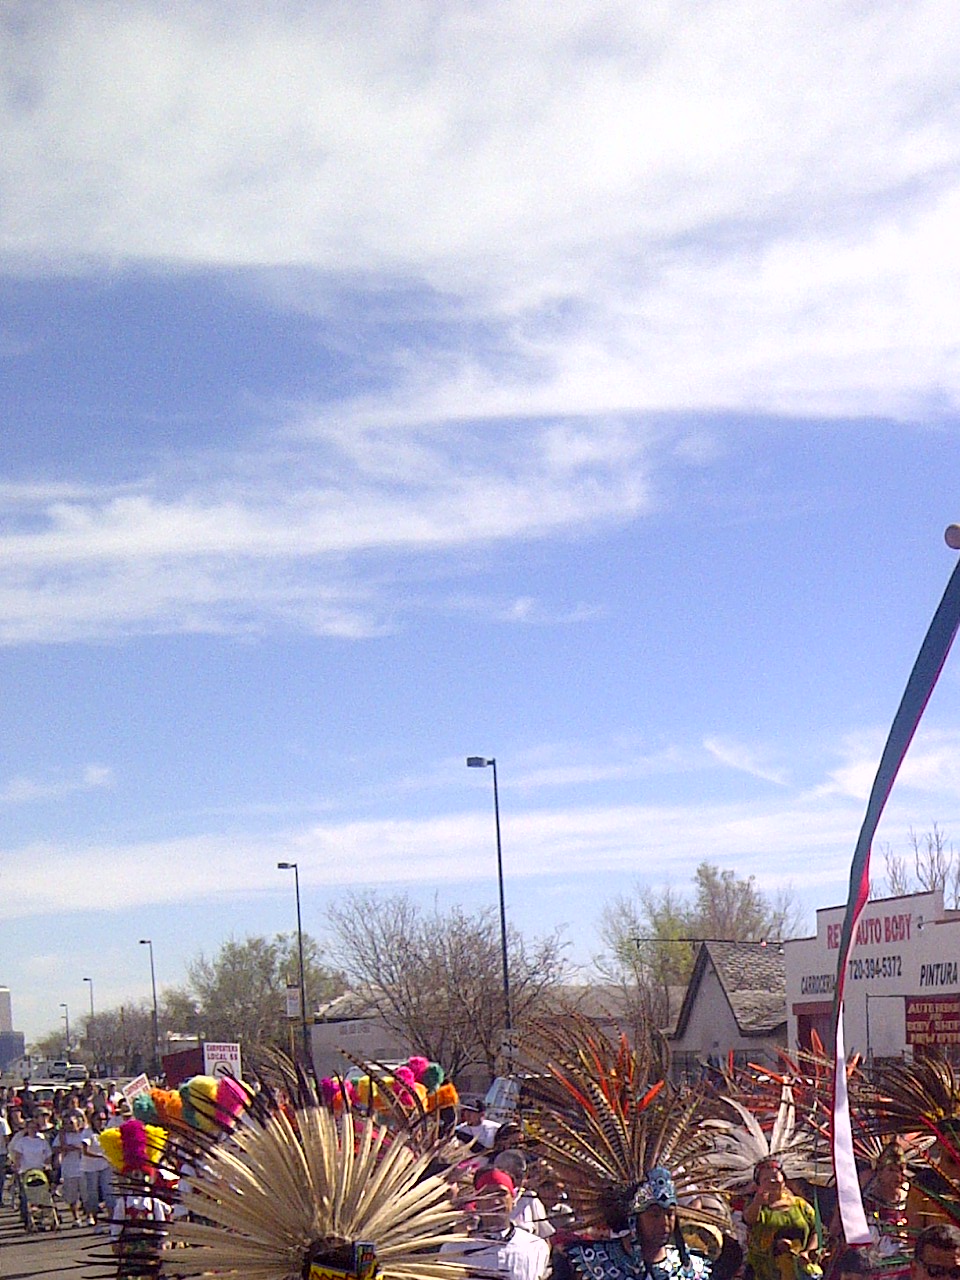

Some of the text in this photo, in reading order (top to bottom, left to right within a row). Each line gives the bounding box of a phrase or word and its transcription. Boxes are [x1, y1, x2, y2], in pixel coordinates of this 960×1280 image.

[827, 913, 912, 950] RE AUTO BODY
[919, 962, 958, 987] PINTURA
